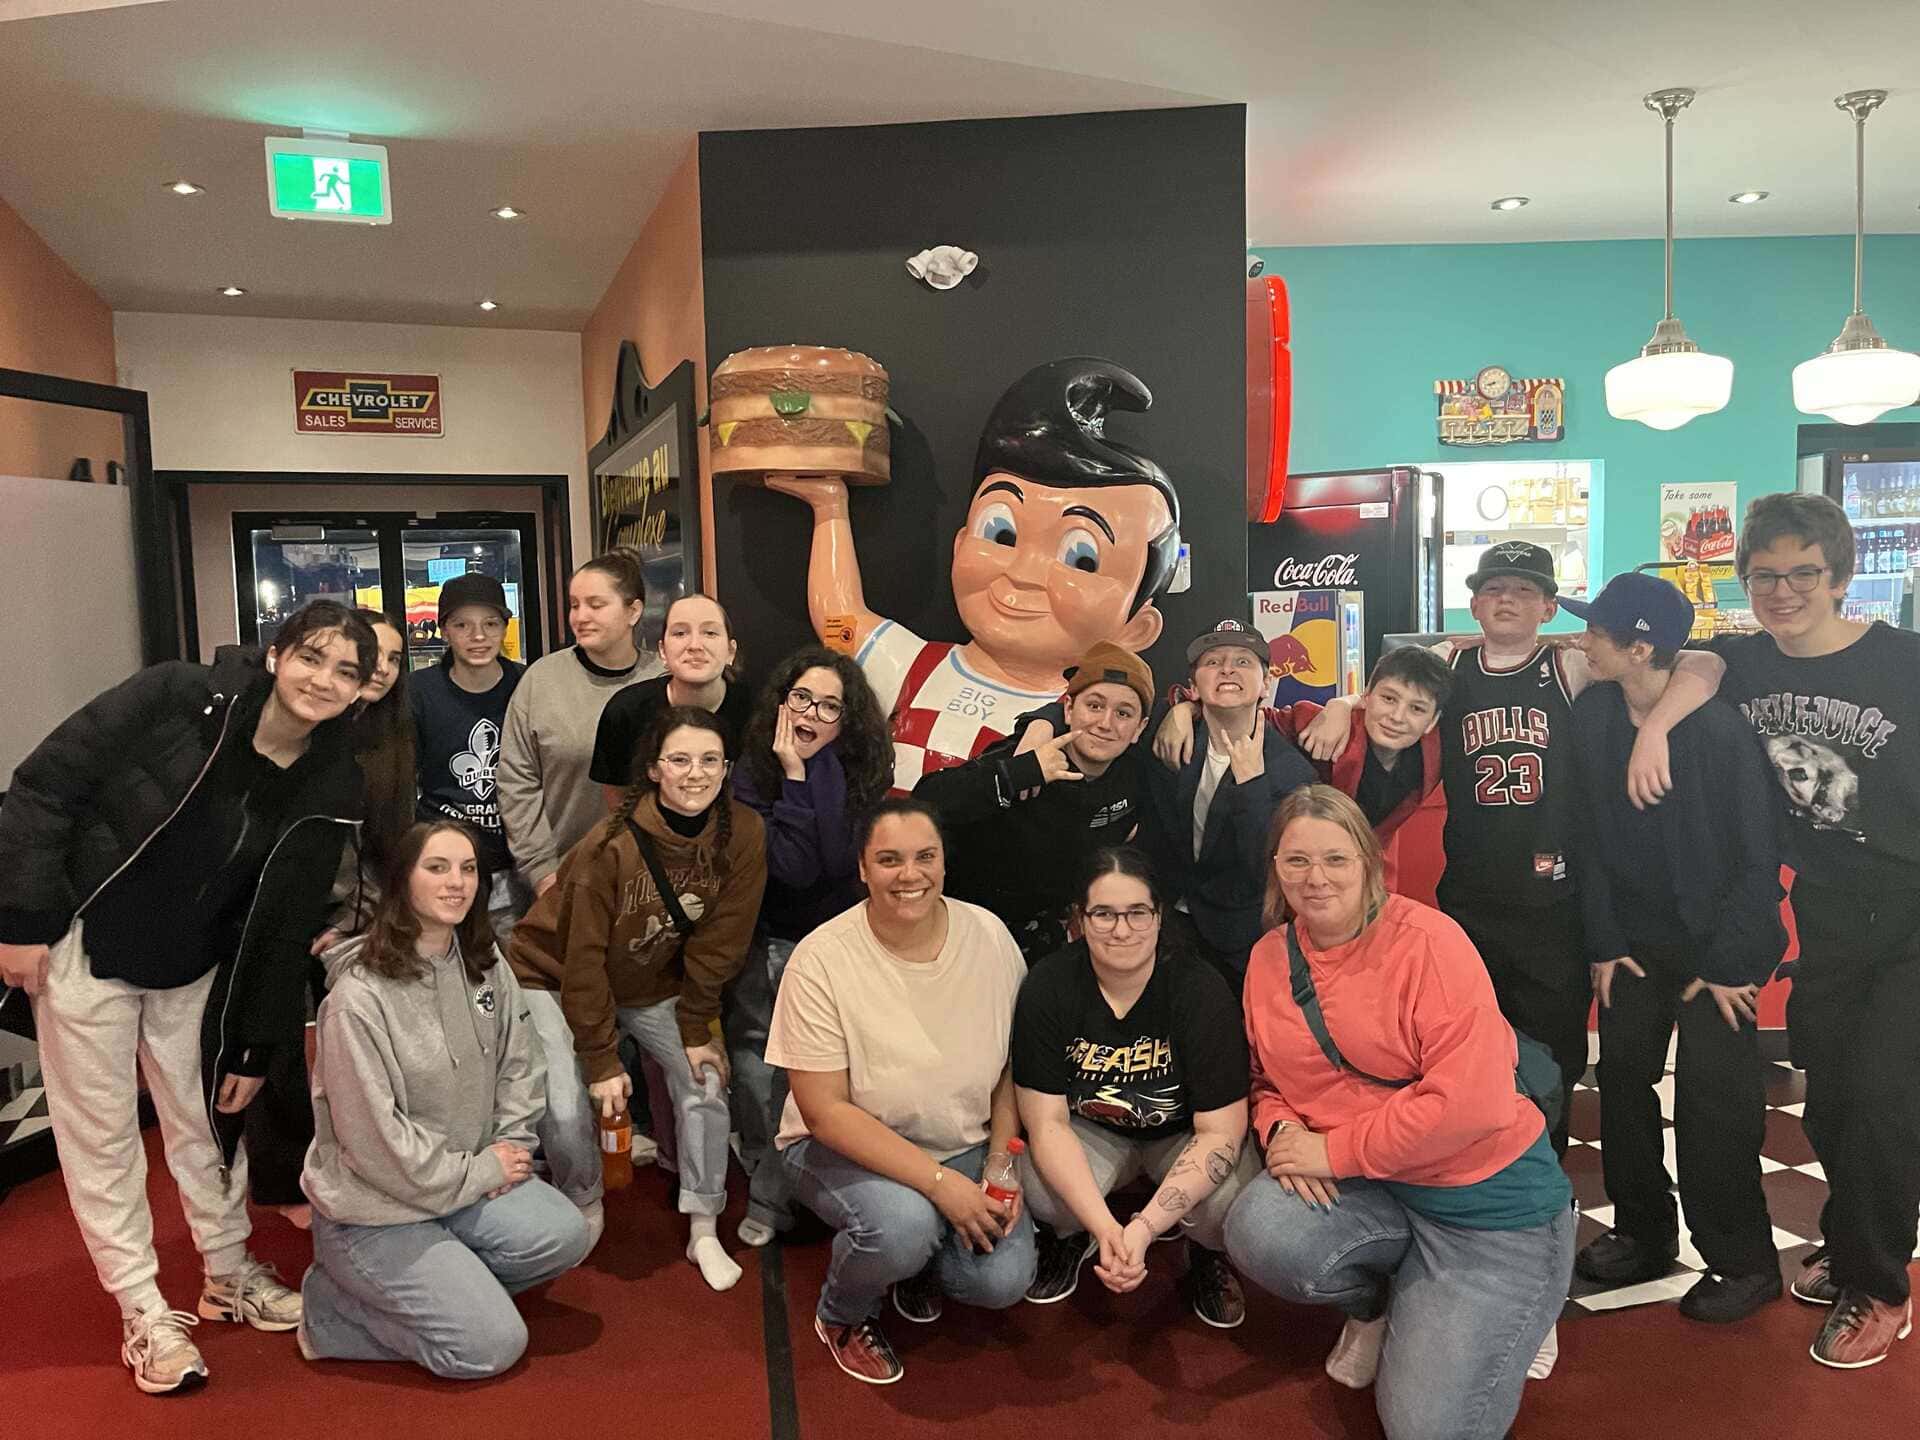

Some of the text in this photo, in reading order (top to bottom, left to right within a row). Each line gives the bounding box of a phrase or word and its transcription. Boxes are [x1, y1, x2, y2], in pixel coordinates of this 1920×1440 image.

[316, 393, 419, 407] CHEVROLET
[305, 414, 346, 427] SALES
[395, 417, 438, 429] SERVICE
[652, 443, 669, 495] au
[1664, 489, 1685, 501] Take
[1274, 553, 1360, 588] Coca-Cola
[1260, 596, 1329, 613] Red Bull
[960, 687, 997, 707] BIG
[947, 699, 995, 721] BOY
[1462, 706, 1549, 756] BULLS
[1475, 752, 1543, 806] 23
